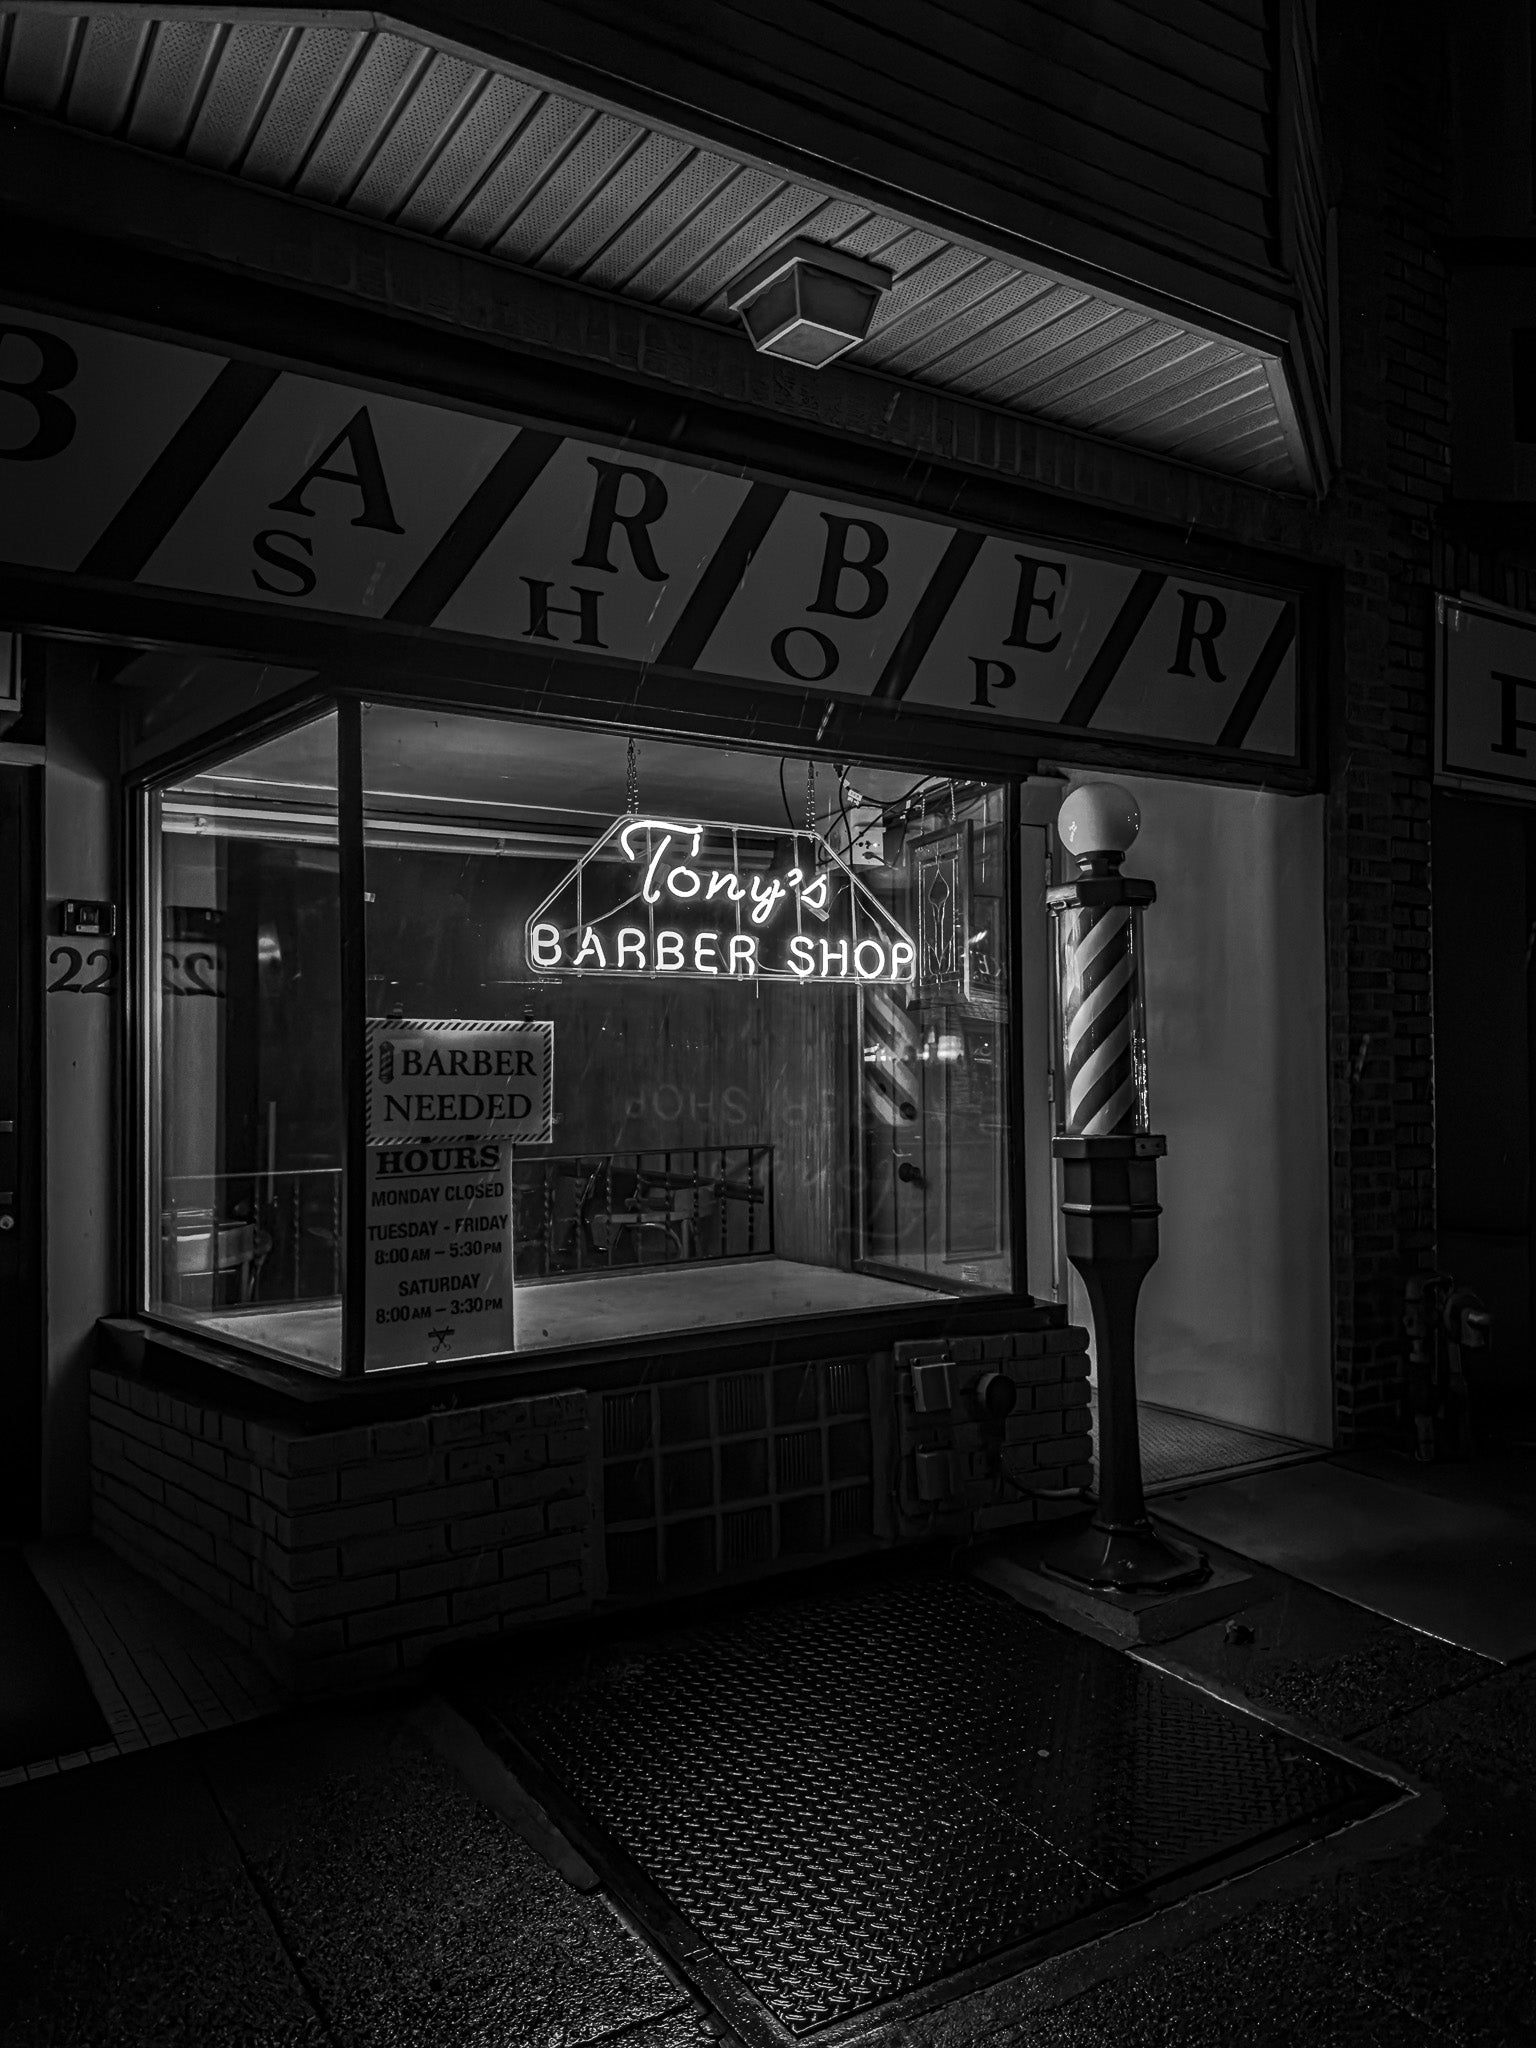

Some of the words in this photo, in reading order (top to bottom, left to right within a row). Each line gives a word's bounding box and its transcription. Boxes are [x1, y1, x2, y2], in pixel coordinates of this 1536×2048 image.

[252, 529, 1016, 708] SHOP
[620, 820, 828, 923] Tony's
[532, 924, 757, 975] BARBER
[787, 936, 914, 979] SHOP
[47, 946, 118, 994] 22
[401, 1050, 537, 1077] BARBER
[384, 1094, 532, 1122] NEEDED
[376, 1145, 499, 1175] HOURS
[371, 1187, 440, 1207] MONDAY
[444, 1182, 504, 1202] CLOSED
[367, 1220, 439, 1241] TUESDAY
[455, 1214, 508, 1234] FRIDAY
[398, 1273, 480, 1297] SATURDAY
